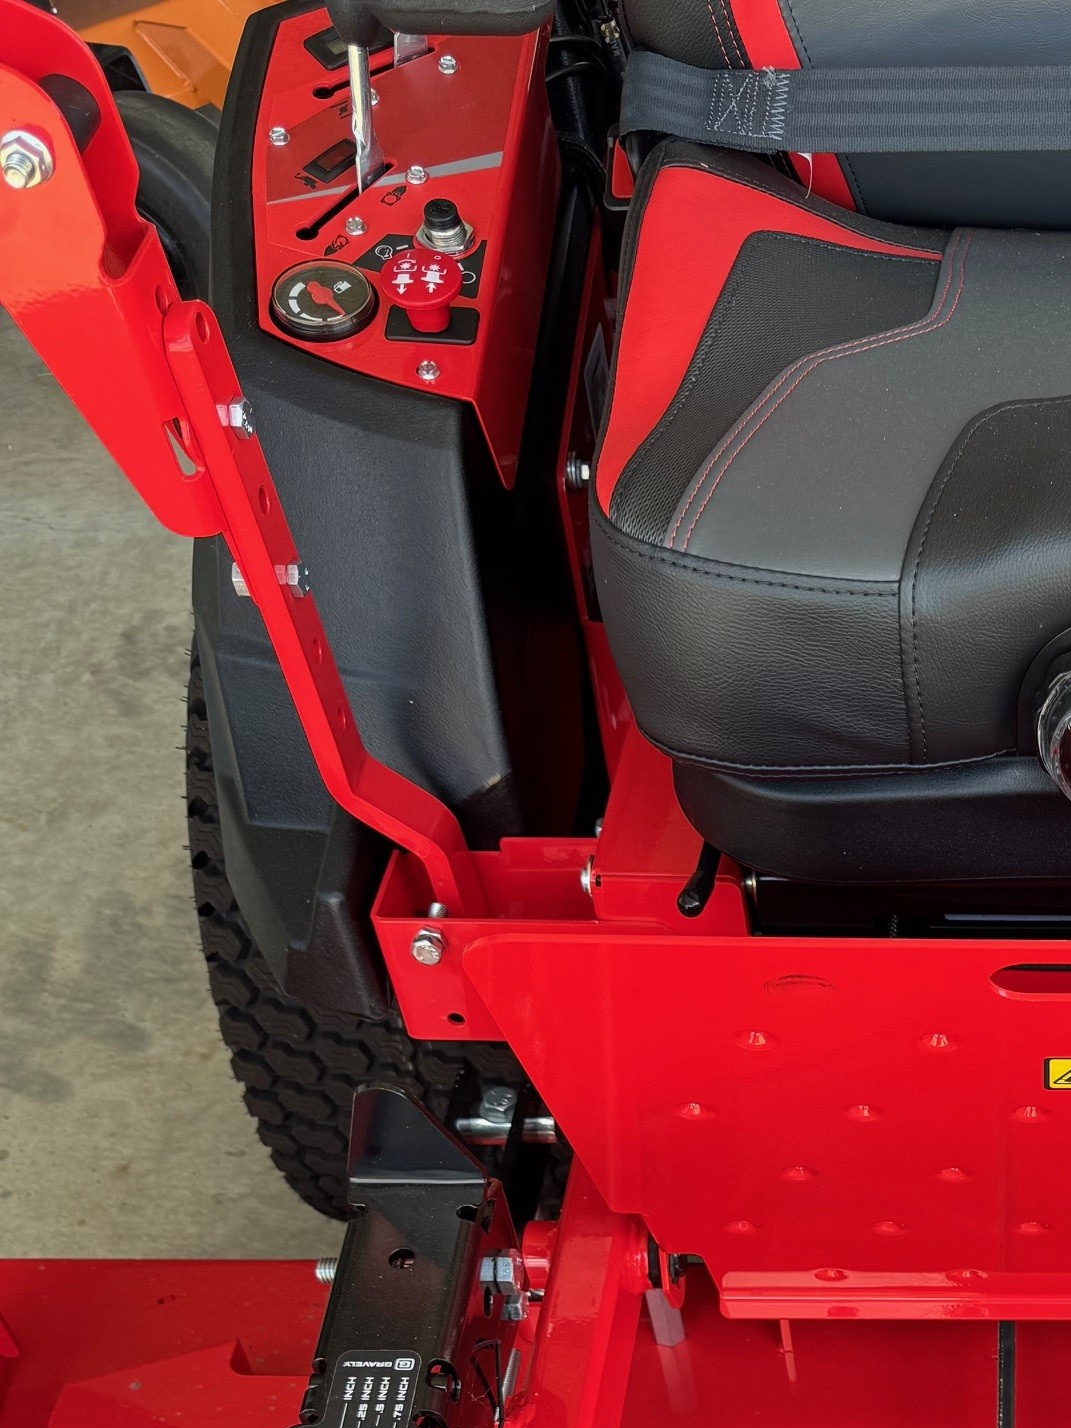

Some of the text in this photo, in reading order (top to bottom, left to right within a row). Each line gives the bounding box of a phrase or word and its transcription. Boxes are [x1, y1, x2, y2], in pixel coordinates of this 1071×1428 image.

[343, 1376, 357, 1401] INCH
[357, 1376, 375, 1421] .25 INCH
[375, 1376, 391, 1414] .5 INCH
[393, 1376, 410, 1421] .75 INCH
